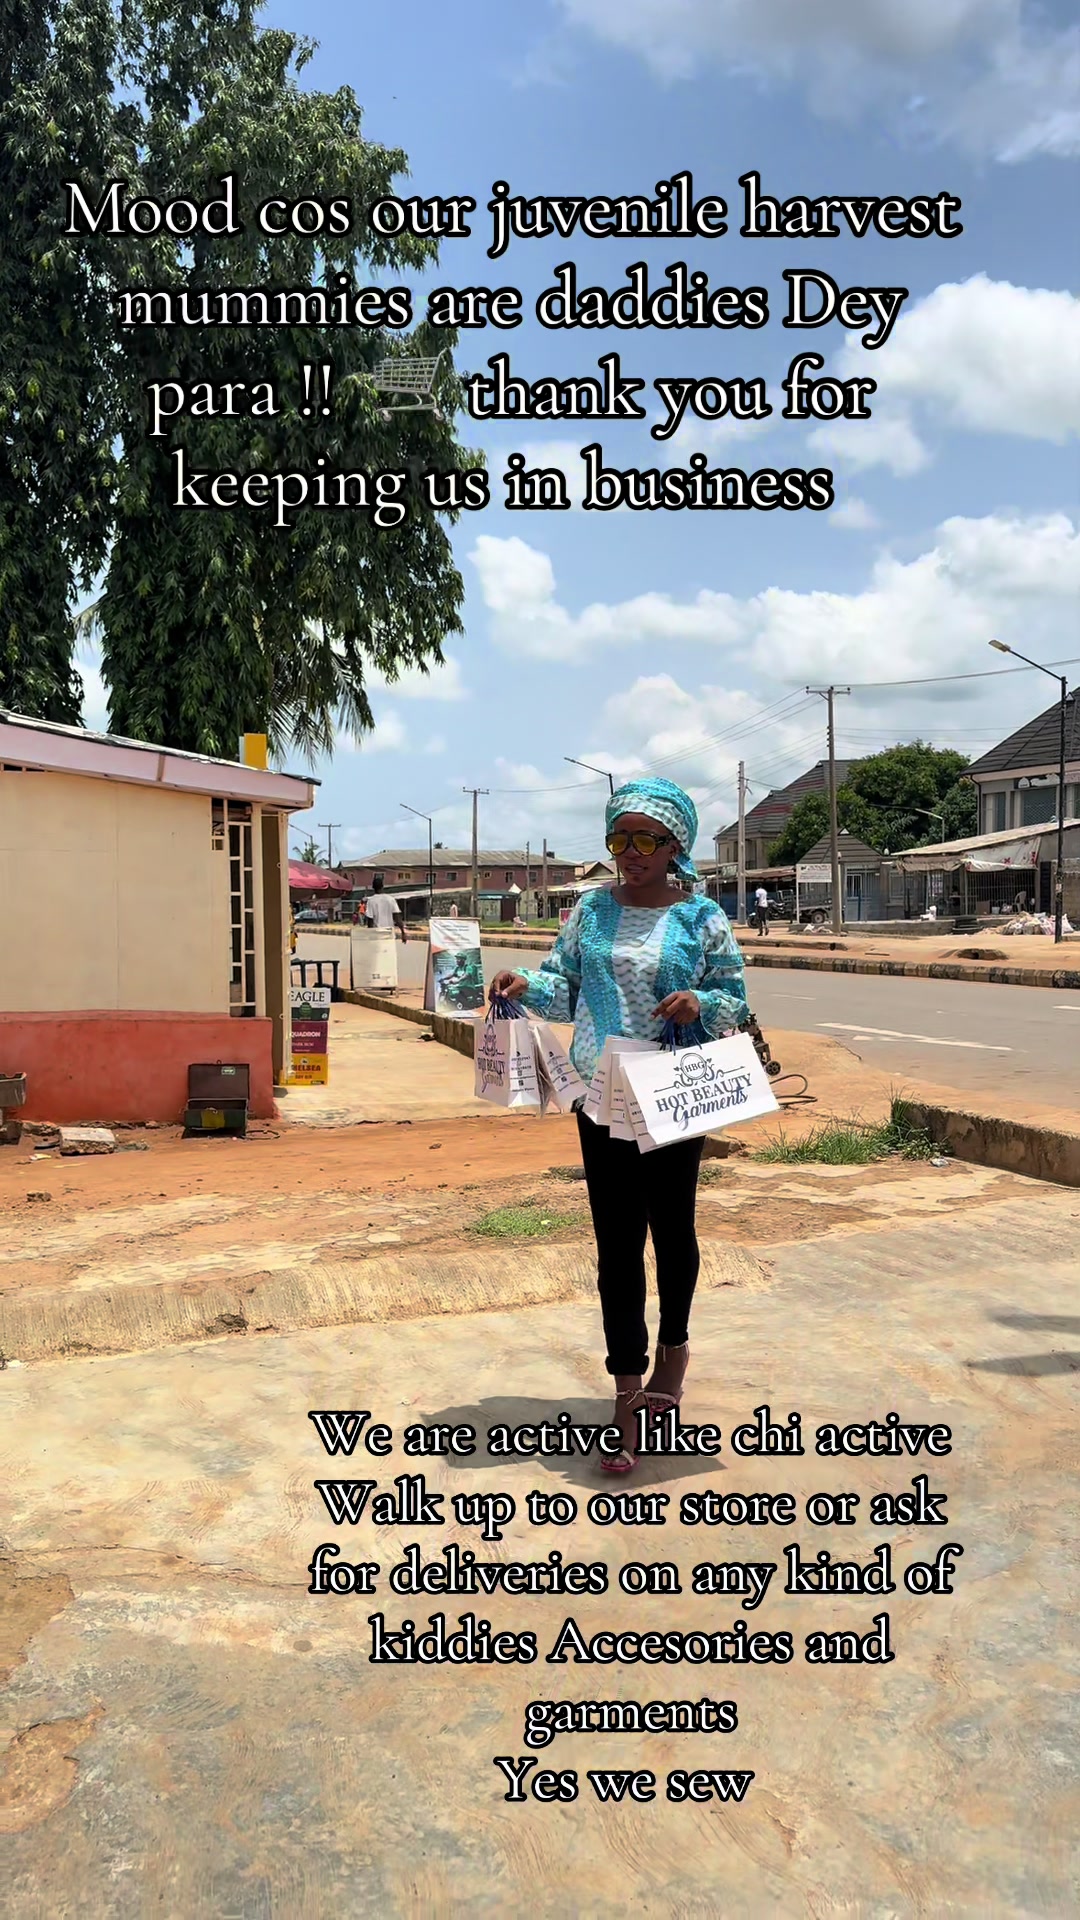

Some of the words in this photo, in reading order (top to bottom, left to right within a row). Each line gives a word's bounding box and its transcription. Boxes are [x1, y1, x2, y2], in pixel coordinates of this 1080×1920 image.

[684, 1060, 706, 1073] HBG
[655, 1091, 689, 1113] HOT
[690, 1073, 752, 1103] BEAUTY
[672, 1085, 749, 1131] Garments
